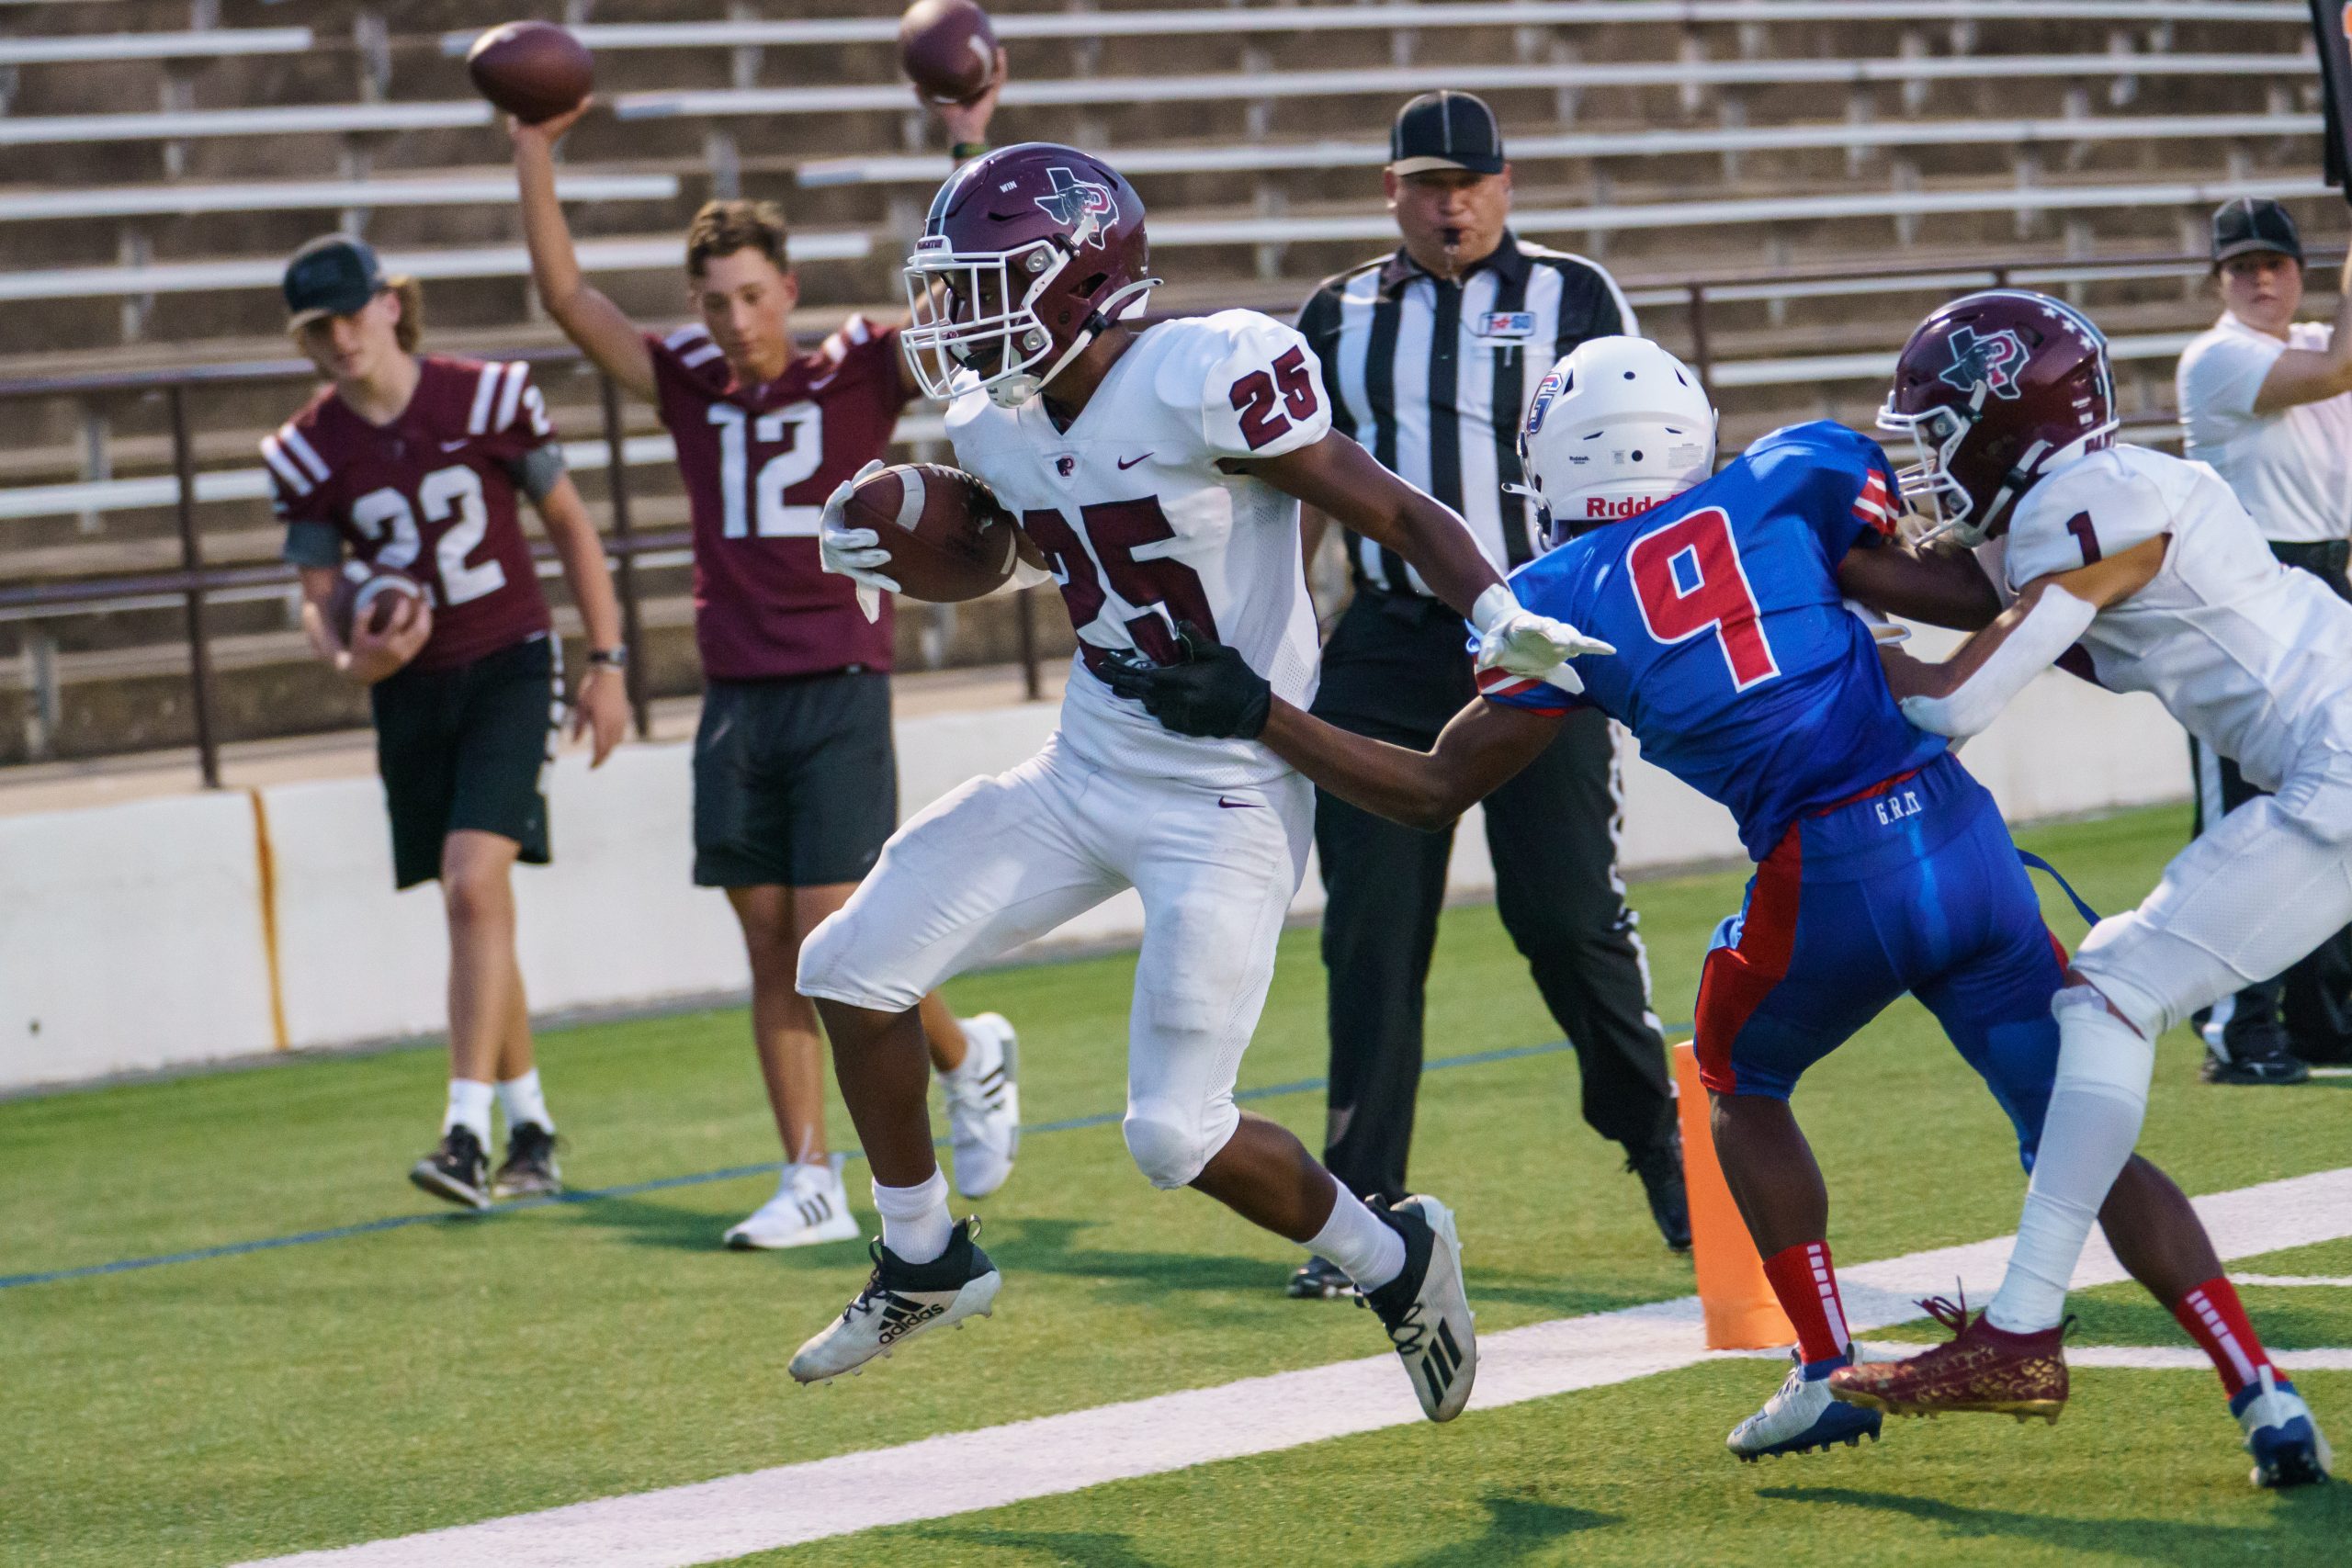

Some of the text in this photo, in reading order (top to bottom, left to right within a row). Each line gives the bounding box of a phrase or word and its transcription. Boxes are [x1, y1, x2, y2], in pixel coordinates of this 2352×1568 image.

[1228, 344, 1317, 451] 25
[707, 400, 823, 538] 12
[1587, 494, 1678, 517] Ridd
[1023, 494, 1220, 683] 25
[2065, 511, 2102, 566] 1
[1626, 506, 1781, 693] 9
[879, 1303, 945, 1344] adidas
